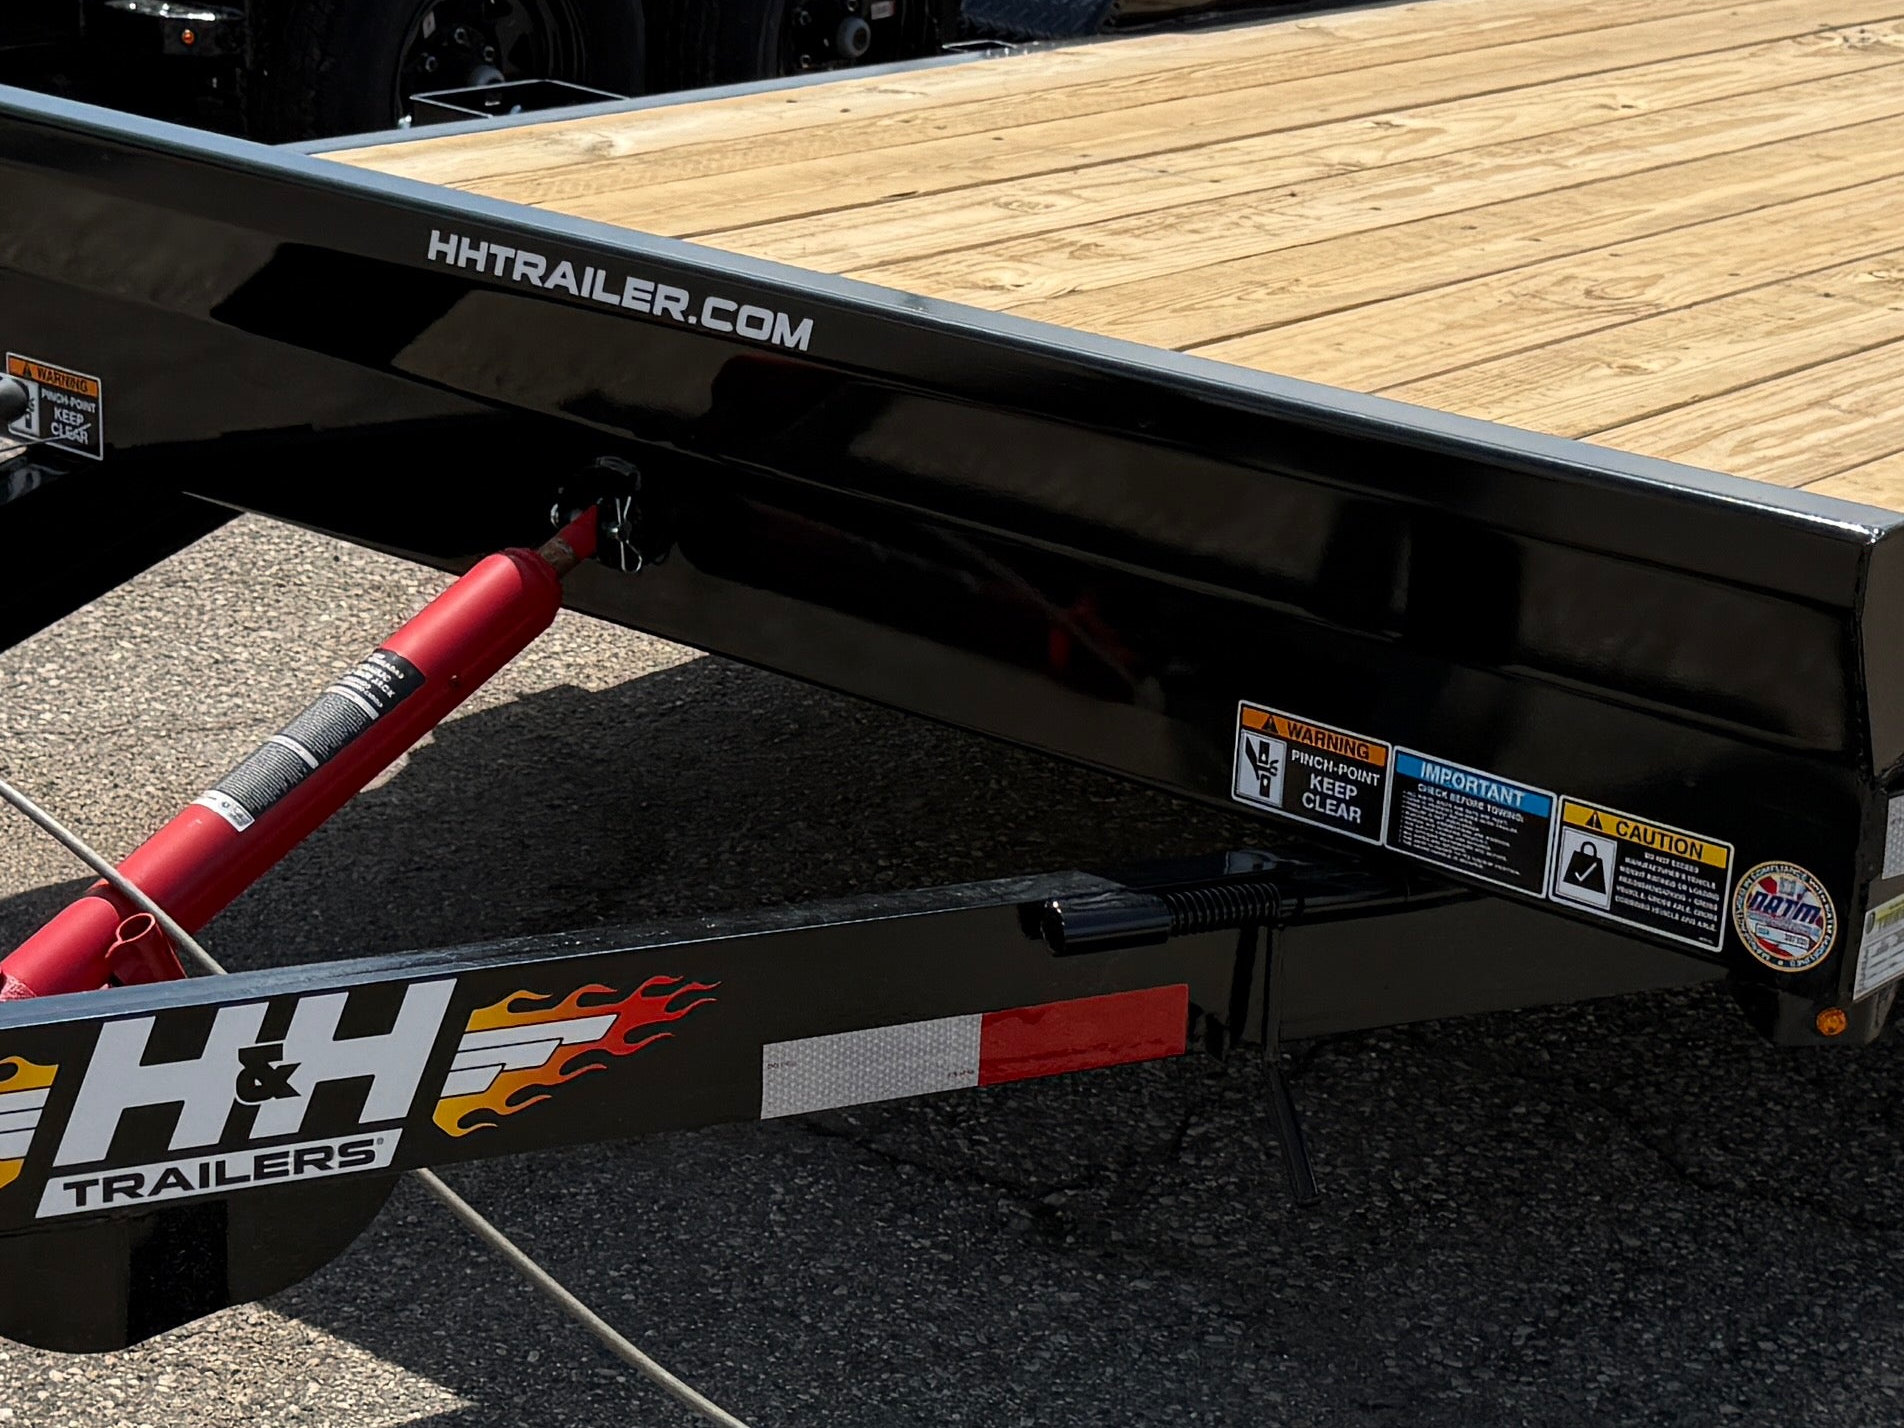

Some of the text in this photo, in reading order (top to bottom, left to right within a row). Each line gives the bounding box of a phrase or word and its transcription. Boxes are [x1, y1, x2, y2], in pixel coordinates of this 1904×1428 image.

[427, 229, 814, 352] HHTRAILER.COM
[37, 367, 88, 393] WARNING
[41, 388, 96, 413] PINCH-POINT
[54, 406, 84, 426] KEEP
[51, 422, 89, 445] CLEAR
[1287, 721, 1370, 761] WARNING
[1291, 749, 1380, 786] PINCH-POINT
[1420, 760, 1525, 807] IMPORTANT
[1310, 773, 1358, 801] KEEP
[1302, 792, 1361, 824] CLEAR
[1616, 821, 1704, 860] CAUTION
[52, 978, 458, 1168] H&H
[62, 1138, 377, 1208] TRAILERS
